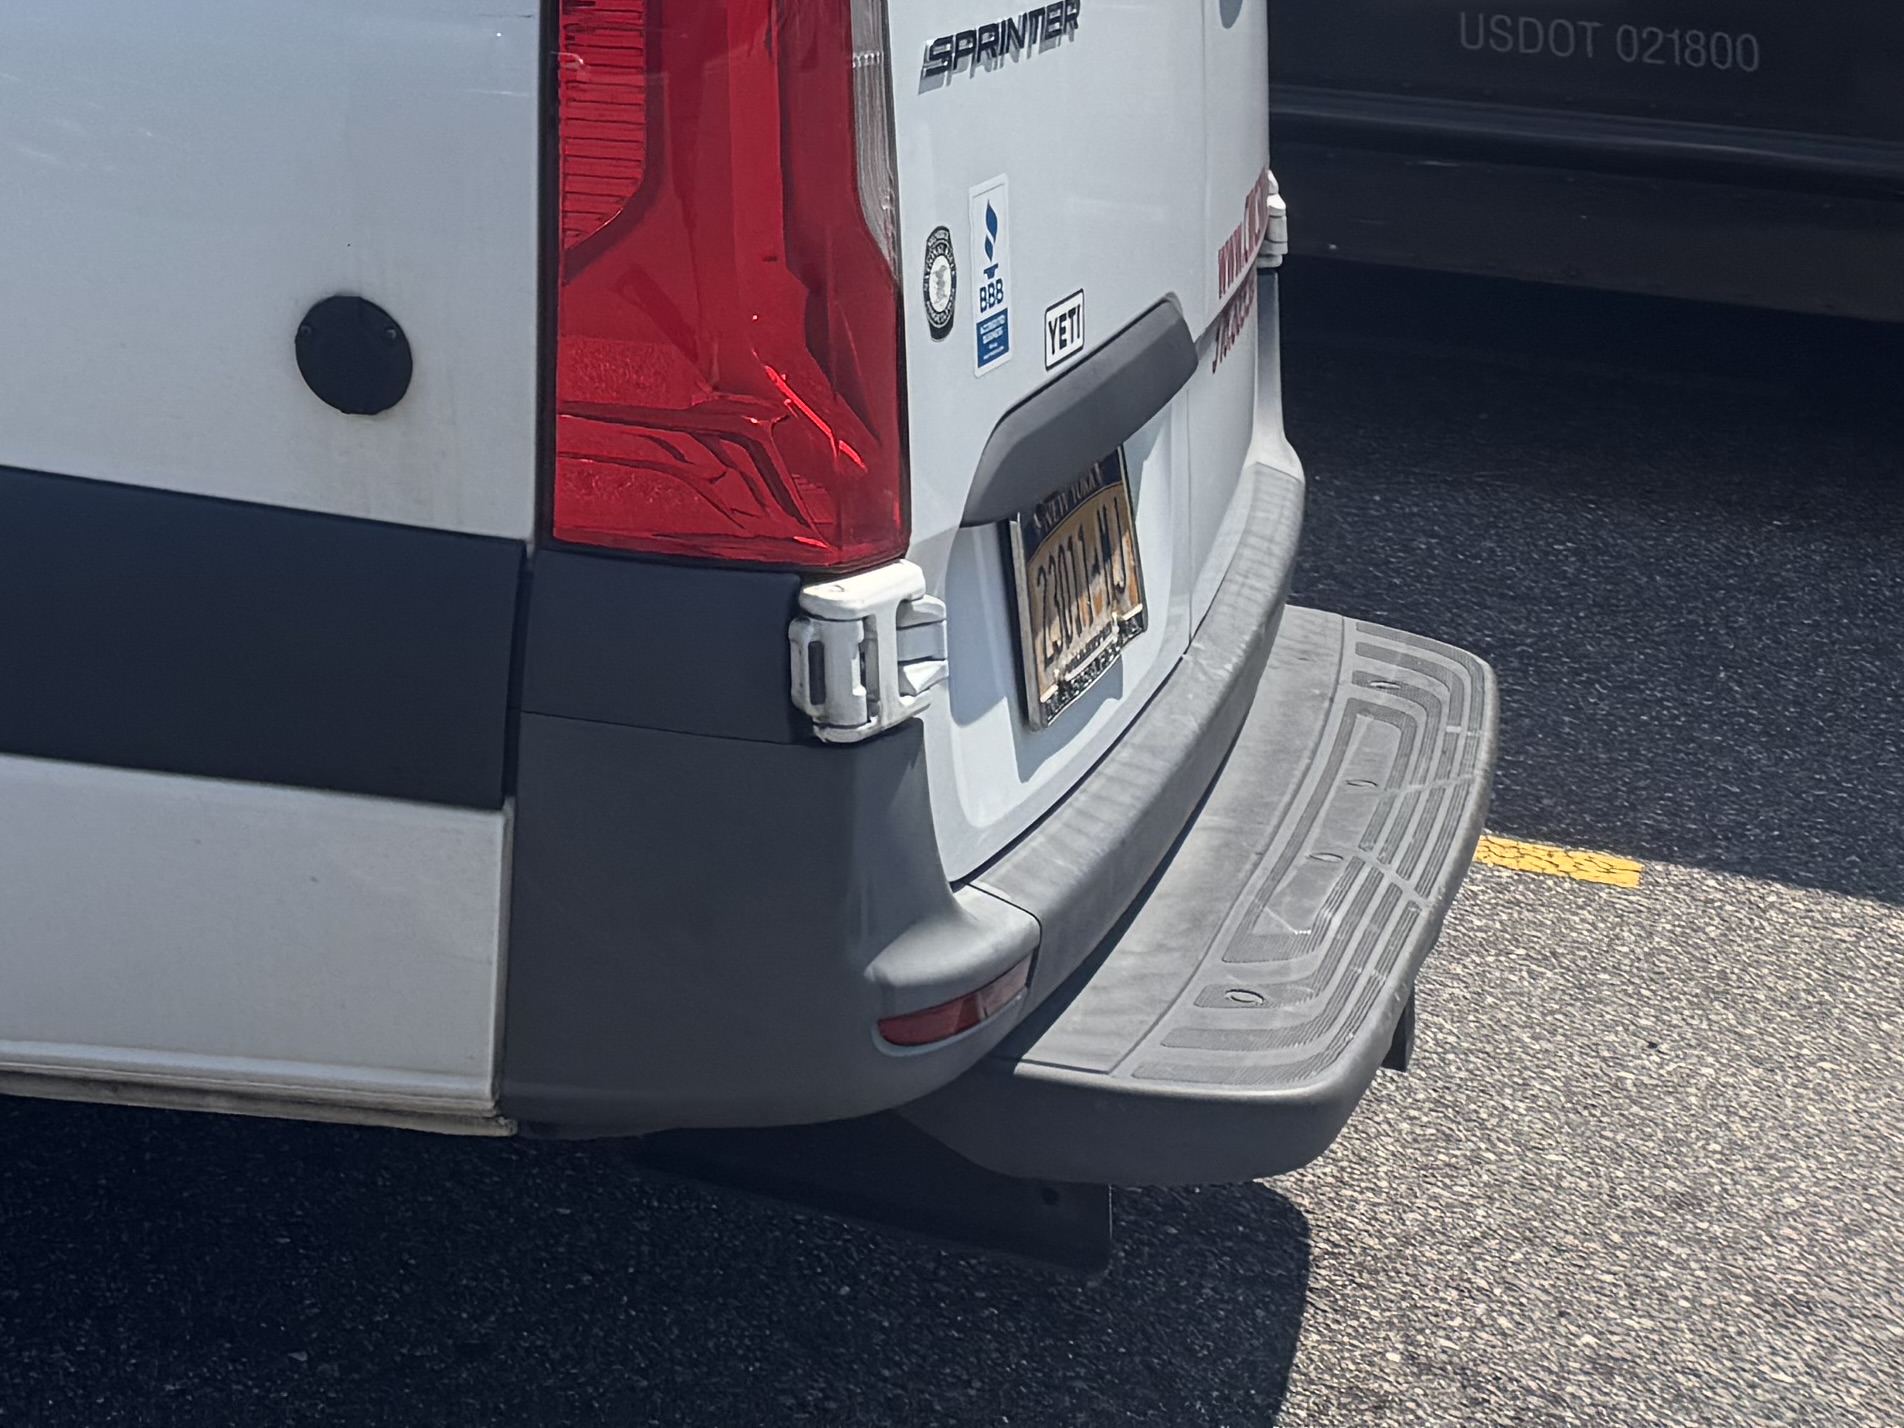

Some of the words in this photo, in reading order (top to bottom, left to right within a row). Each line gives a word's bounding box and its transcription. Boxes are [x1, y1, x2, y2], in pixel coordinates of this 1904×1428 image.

[1458, 10, 1602, 59] USDOT
[1615, 23, 1760, 73] 021800
[979, 278, 1004, 313] BBB
[1048, 304, 1082, 356] YETI
